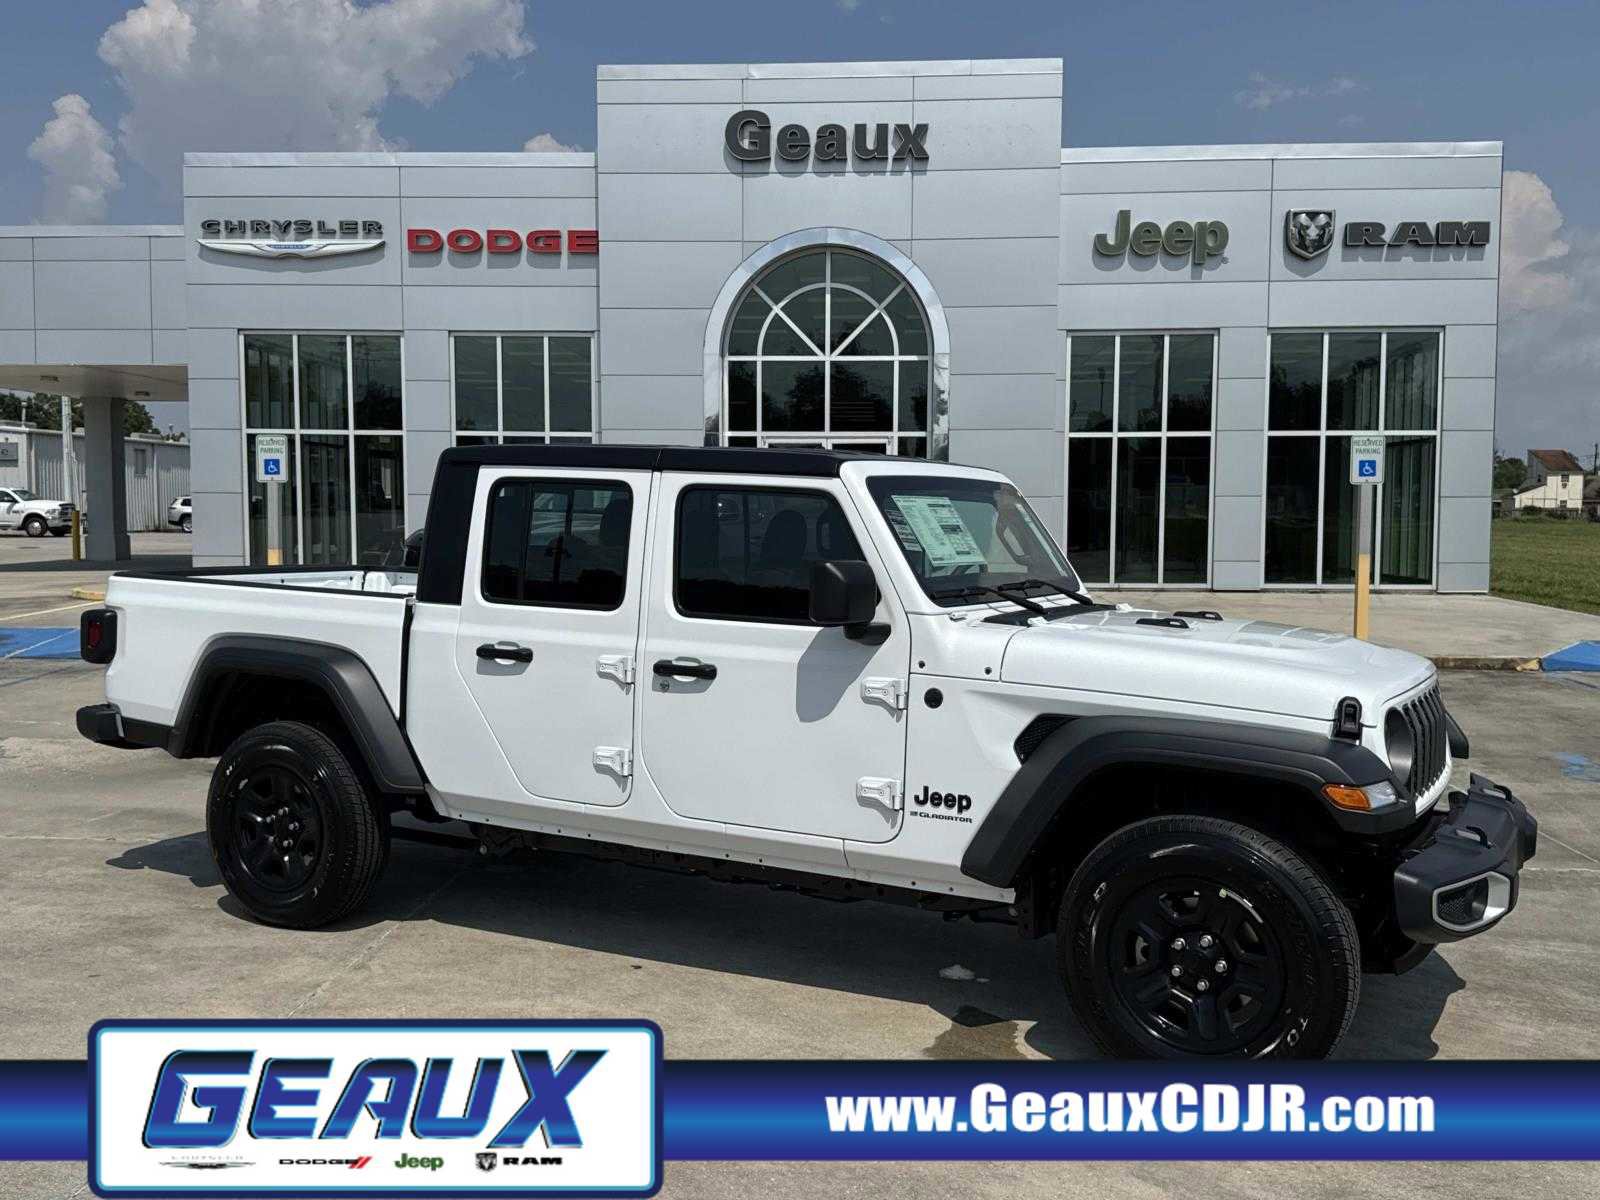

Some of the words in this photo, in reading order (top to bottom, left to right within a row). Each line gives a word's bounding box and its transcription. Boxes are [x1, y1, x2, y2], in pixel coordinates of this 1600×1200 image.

[725, 110, 929, 161] Geaux
[201, 220, 385, 235] CHRYSLER
[1093, 210, 1229, 264] Jeep
[1344, 221, 1490, 246] RAM
[407, 229, 599, 255] DODGE
[913, 785, 972, 815] Jeep
[919, 812, 973, 824] GLADIATOR
